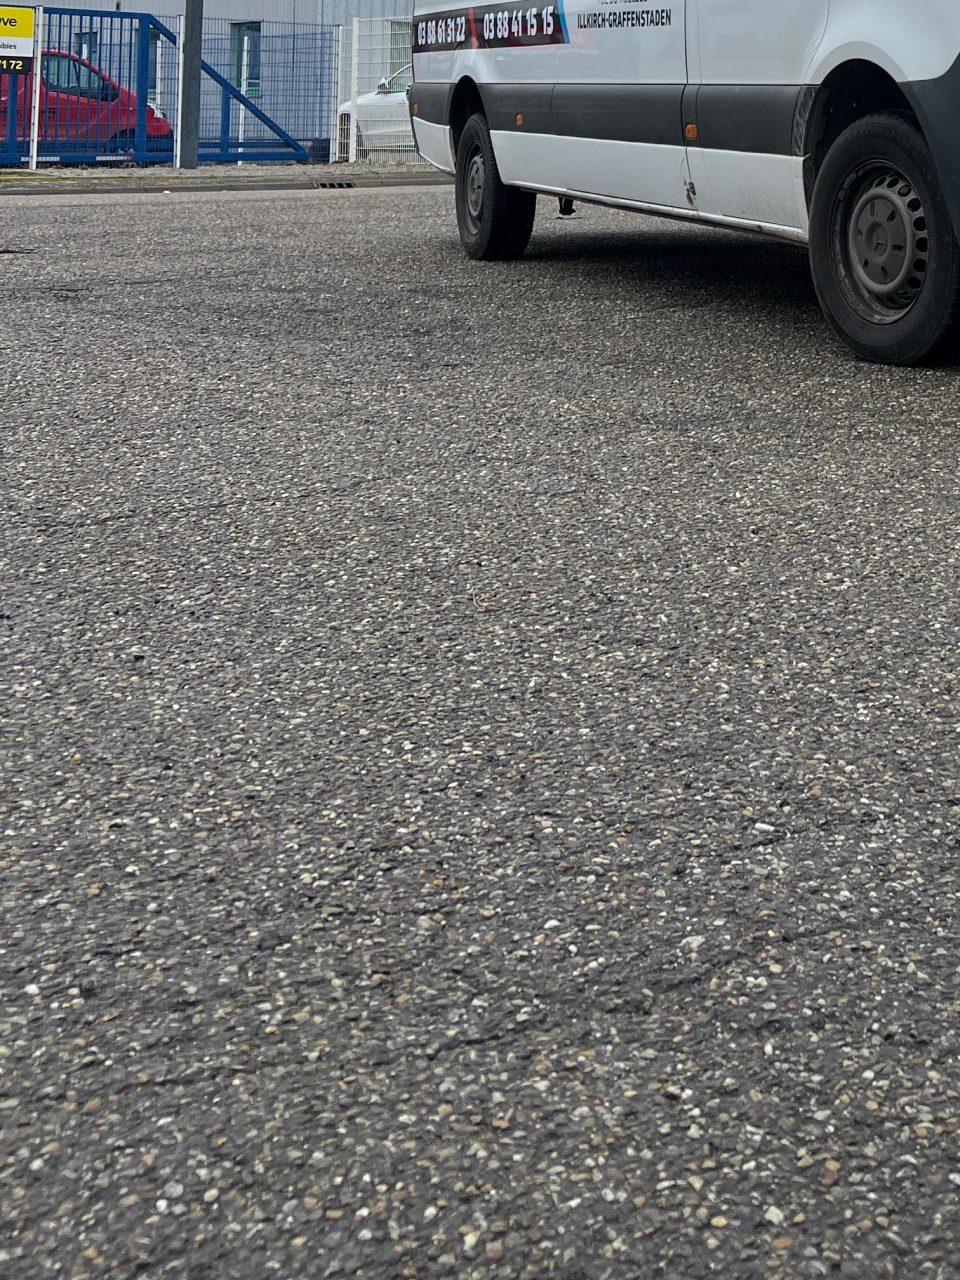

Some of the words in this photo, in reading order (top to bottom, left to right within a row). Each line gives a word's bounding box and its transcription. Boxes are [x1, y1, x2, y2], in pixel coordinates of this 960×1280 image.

[0, 17, 17, 27] ve
[483, 12, 494, 40] 03
[496, 11, 509, 39] 88
[511, 9, 522, 37] 41
[526, 7, 537, 36] 15
[542, 5, 554, 35] 15
[577, 8, 672, 29] ILLKIRCH-GRAFFENSTADEN
[417, 21, 426, 45] 03
[427, 20, 436, 44] 88
[456, 16, 465, 41] 22
[9, 60, 23, 70] 72
